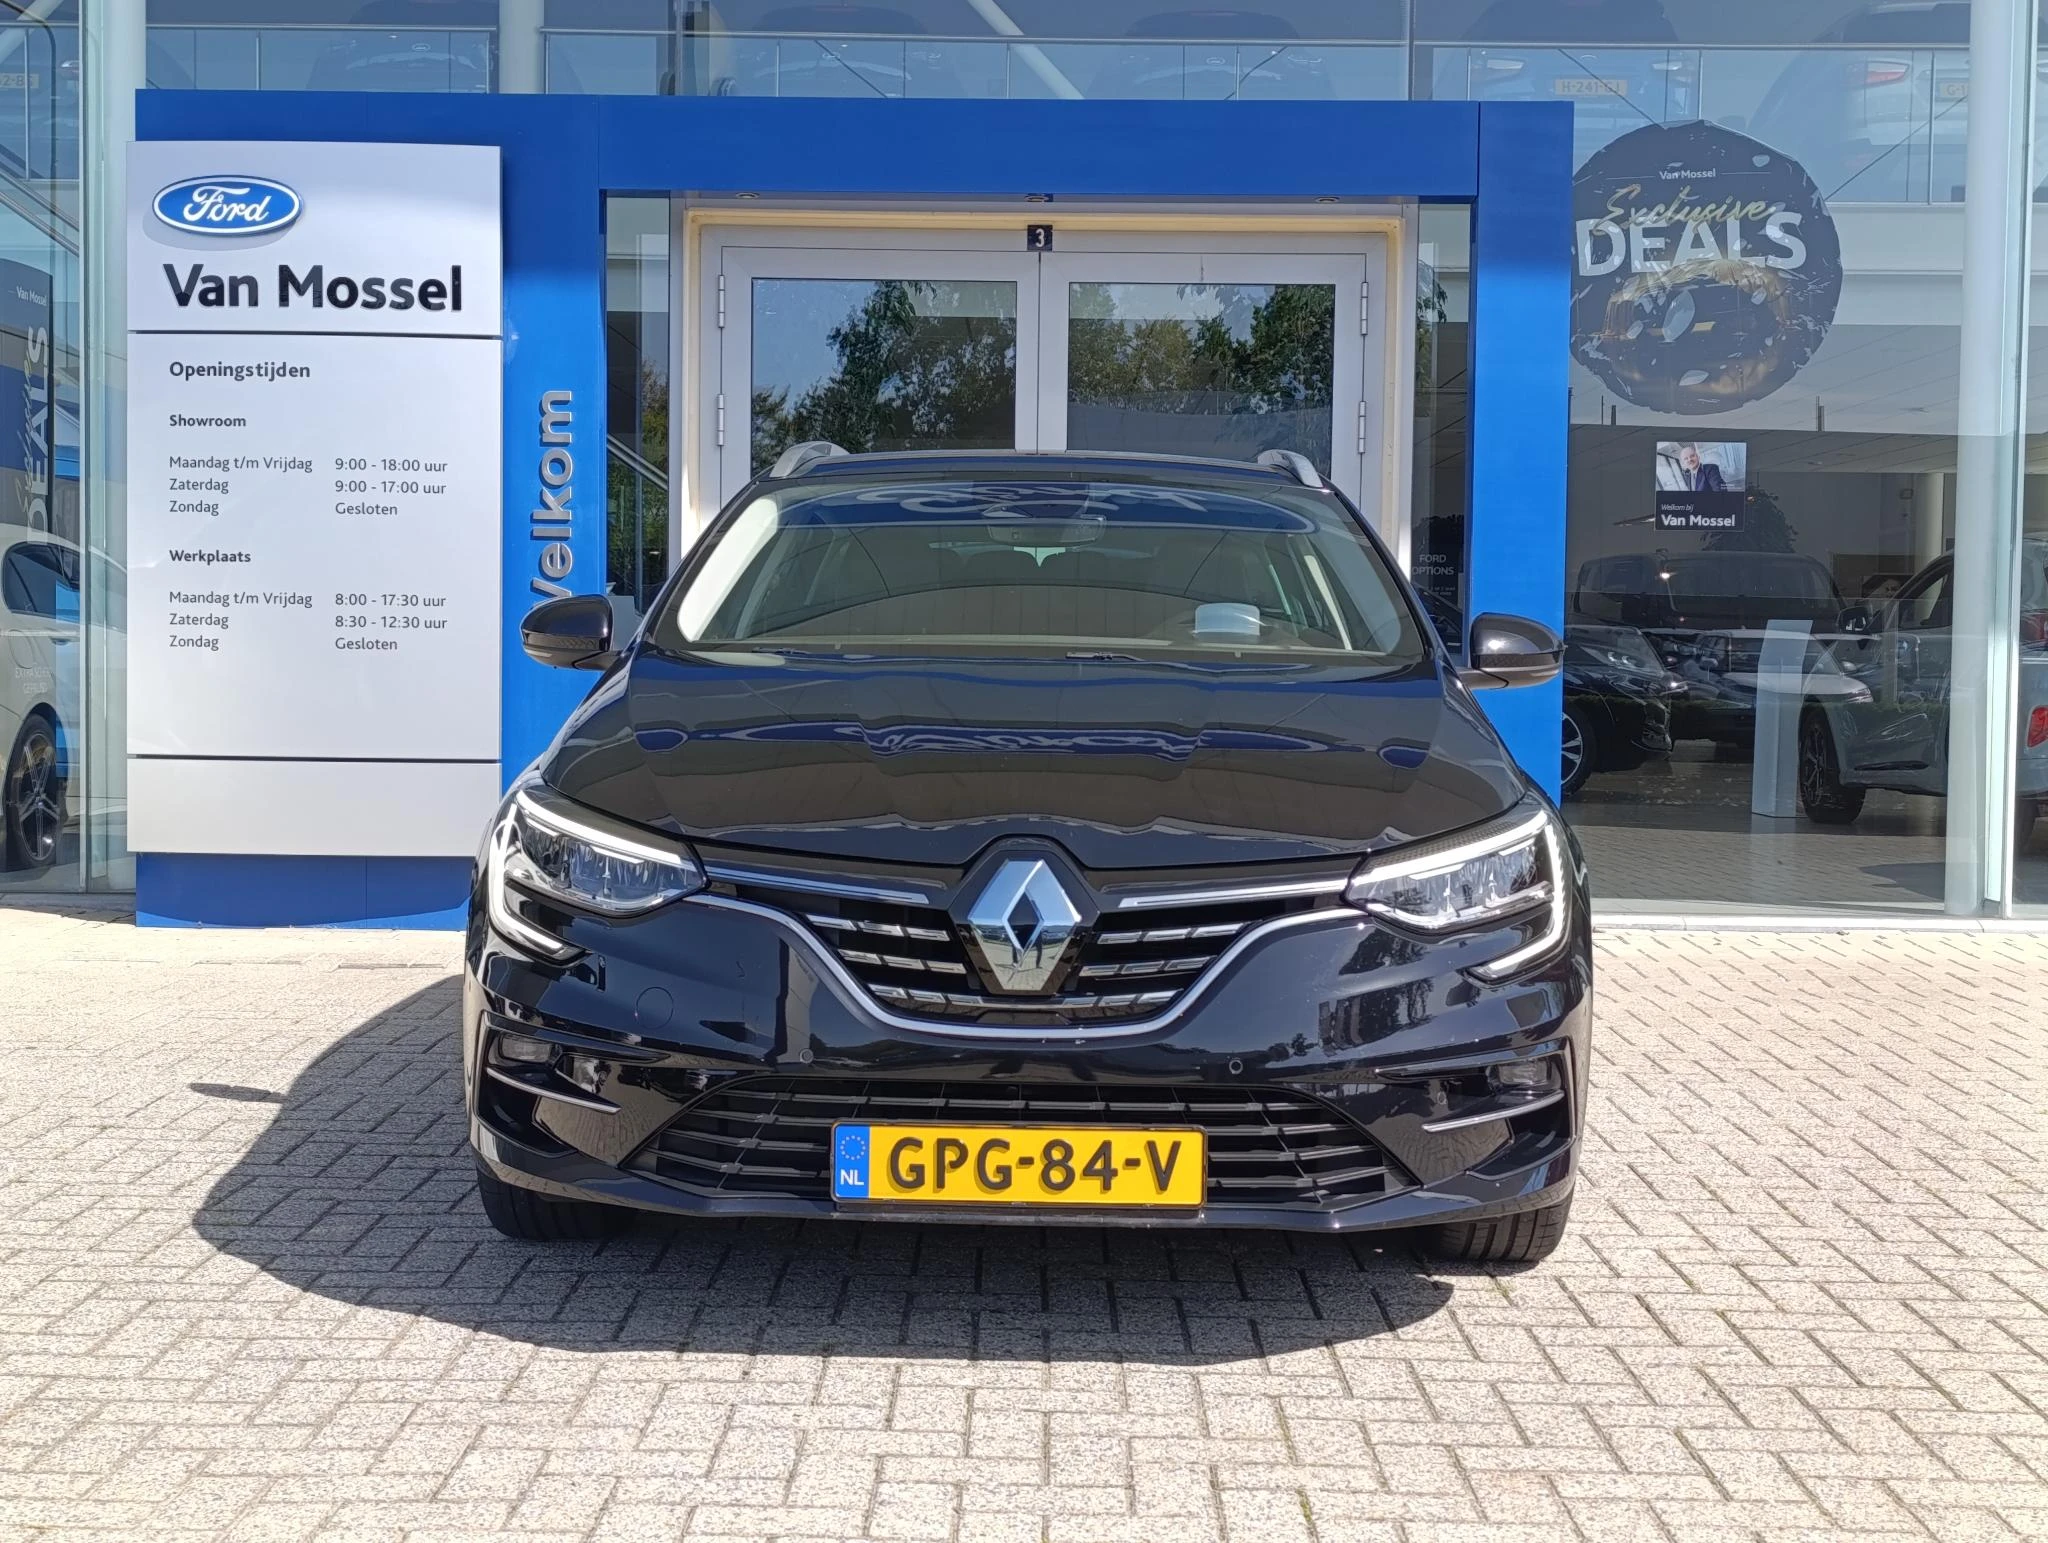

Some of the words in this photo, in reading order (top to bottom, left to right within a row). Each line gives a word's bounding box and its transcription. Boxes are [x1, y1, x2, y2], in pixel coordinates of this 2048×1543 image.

[1658, 170, 1680, 180] Van
[1681, 168, 1717, 179] Mossel
[181, 185, 270, 223] Ford
[1593, 184, 1777, 236] Exclusive
[1035, 228, 1045, 248] 3
[1575, 211, 1807, 277] DEALS
[162, 263, 259, 308] Van
[278, 264, 462, 312] Mossel
[169, 361, 311, 383] Openingstijden
[169, 414, 247, 428] Showroom
[27, 325, 49, 545] DEALS
[169, 456, 230, 473] Maandag
[233, 457, 259, 471] t/m
[263, 457, 313, 474] Vrijdag
[335, 458, 367, 471] 9:00
[381, 459, 421, 472] 18:00
[424, 462, 448, 473] uur
[169, 478, 229, 495] Zaterdag
[335, 480, 367, 493] 9:00
[381, 481, 419, 494] 17:00
[423, 484, 447, 495] uur
[169, 500, 219, 517] Zondag
[335, 502, 398, 516] Gesloten
[1661, 514, 1686, 527] Van
[1689, 514, 1736, 527] Mossel
[169, 548, 252, 567] Werkplaats
[1419, 554, 1447, 564] FORD
[1411, 566, 1455, 576] OPTIONS
[169, 591, 230, 608] Maandag
[233, 592, 259, 606] t/m
[263, 592, 313, 609] Vrijdag
[335, 593, 367, 606] 8:00
[381, 594, 419, 607] 17:30
[423, 597, 447, 607] uur
[169, 613, 229, 630] Zaterdag
[335, 615, 367, 629] 8:30
[381, 616, 420, 629] 12:30
[424, 619, 448, 630] uur
[169, 635, 219, 652] Zondag
[335, 637, 398, 651] Gesloten
[889, 1136, 1182, 1192] GPG-84-V
[840, 1169, 864, 1186] NL
